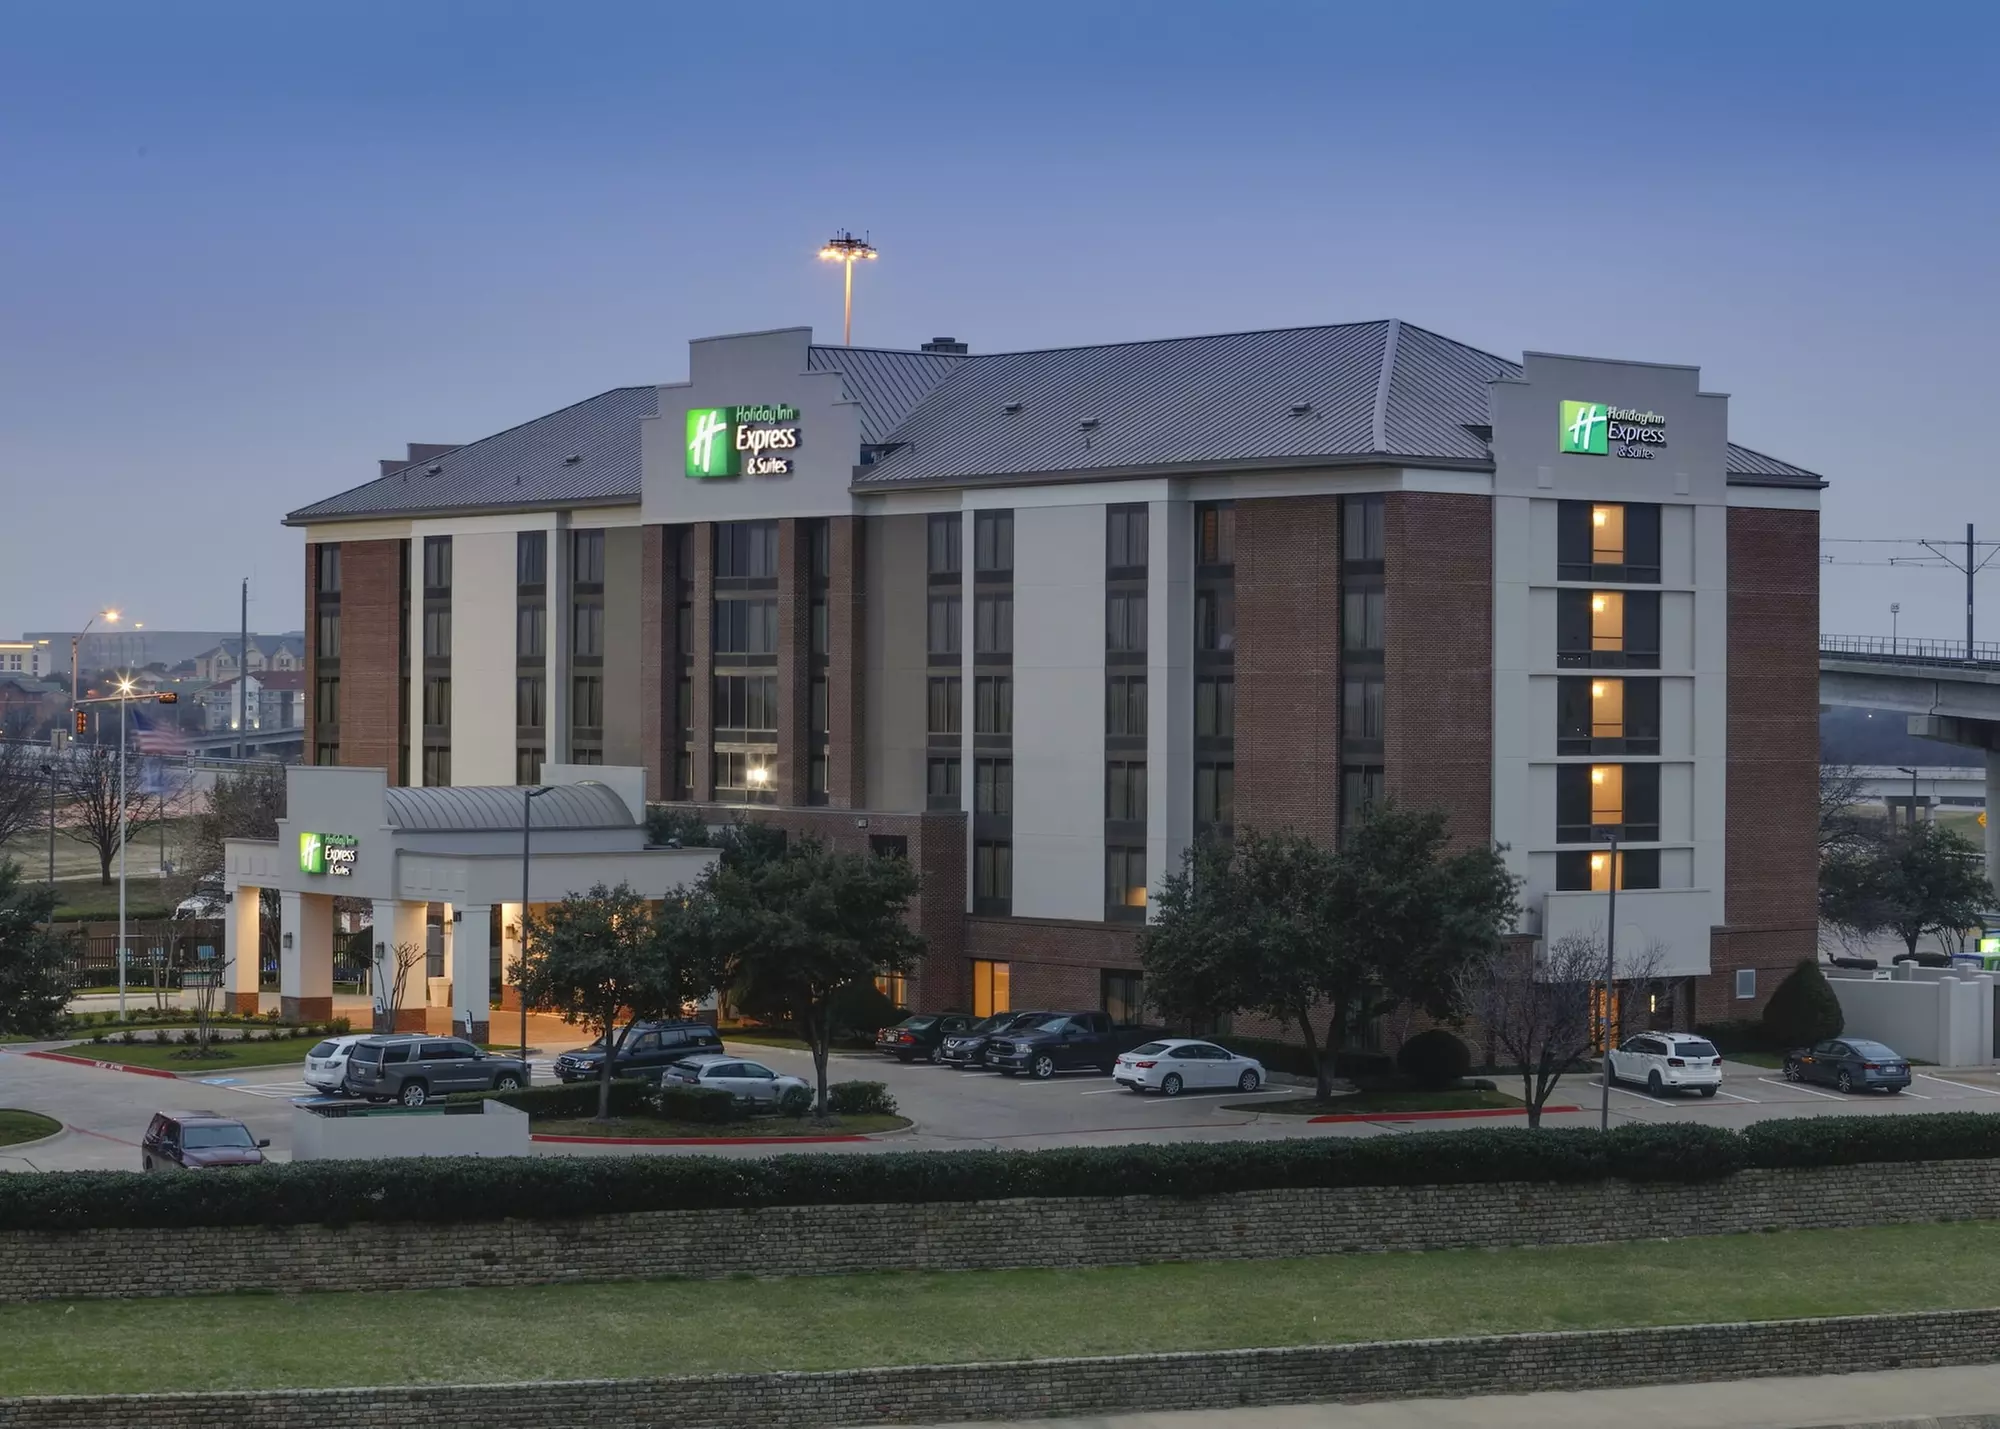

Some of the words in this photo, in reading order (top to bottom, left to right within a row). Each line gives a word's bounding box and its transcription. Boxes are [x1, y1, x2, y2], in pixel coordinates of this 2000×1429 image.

[736, 405, 776, 425] Holiday
[777, 403, 794, 420] Inn
[1607, 406, 1646, 425] Holiday
[1646, 410, 1665, 424] Inn
[736, 424, 796, 456] Express
[1608, 421, 1665, 444] Express
[1618, 445, 1626, 457] &
[1627, 445, 1655, 459] Suites
[747, 457, 756, 475] &
[756, 457, 788, 474] Suites
[324, 845, 355, 864] Express
